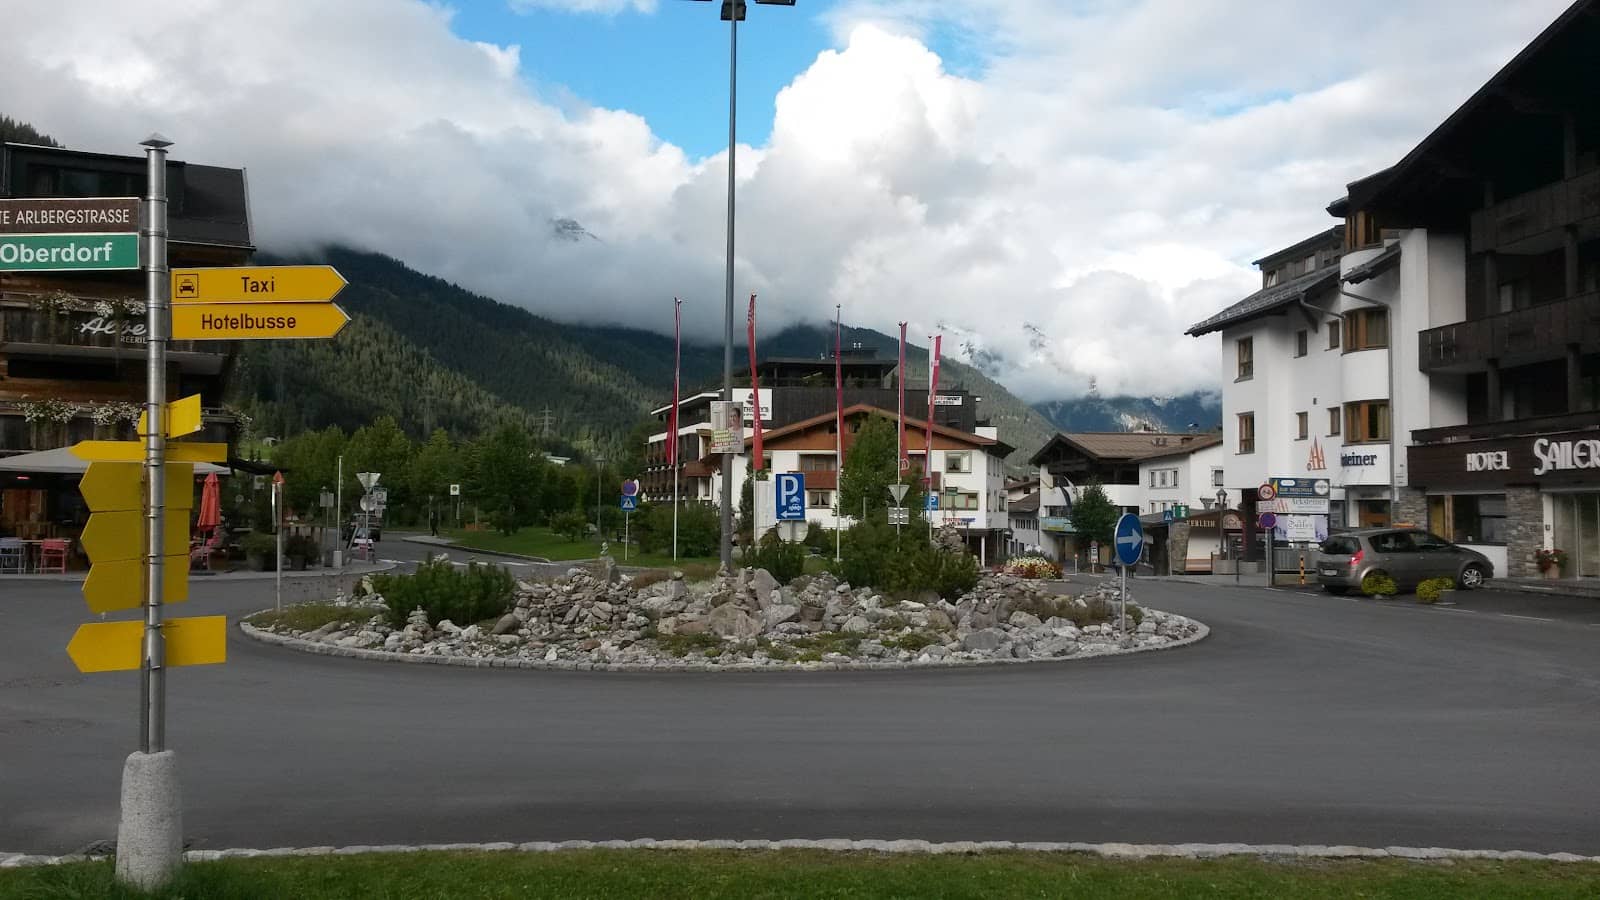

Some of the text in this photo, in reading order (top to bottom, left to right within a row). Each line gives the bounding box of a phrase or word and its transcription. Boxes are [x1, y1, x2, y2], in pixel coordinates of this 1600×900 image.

[16, 208, 130, 224] ARLBERGSTRASSE
[0, 241, 113, 263] Oberdorf
[241, 276, 275, 293] Taxi
[80, 317, 147, 335] Albe
[201, 313, 297, 330] Hotelbusse
[1466, 451, 1510, 471] HOTEL
[780, 475, 799, 506] P
